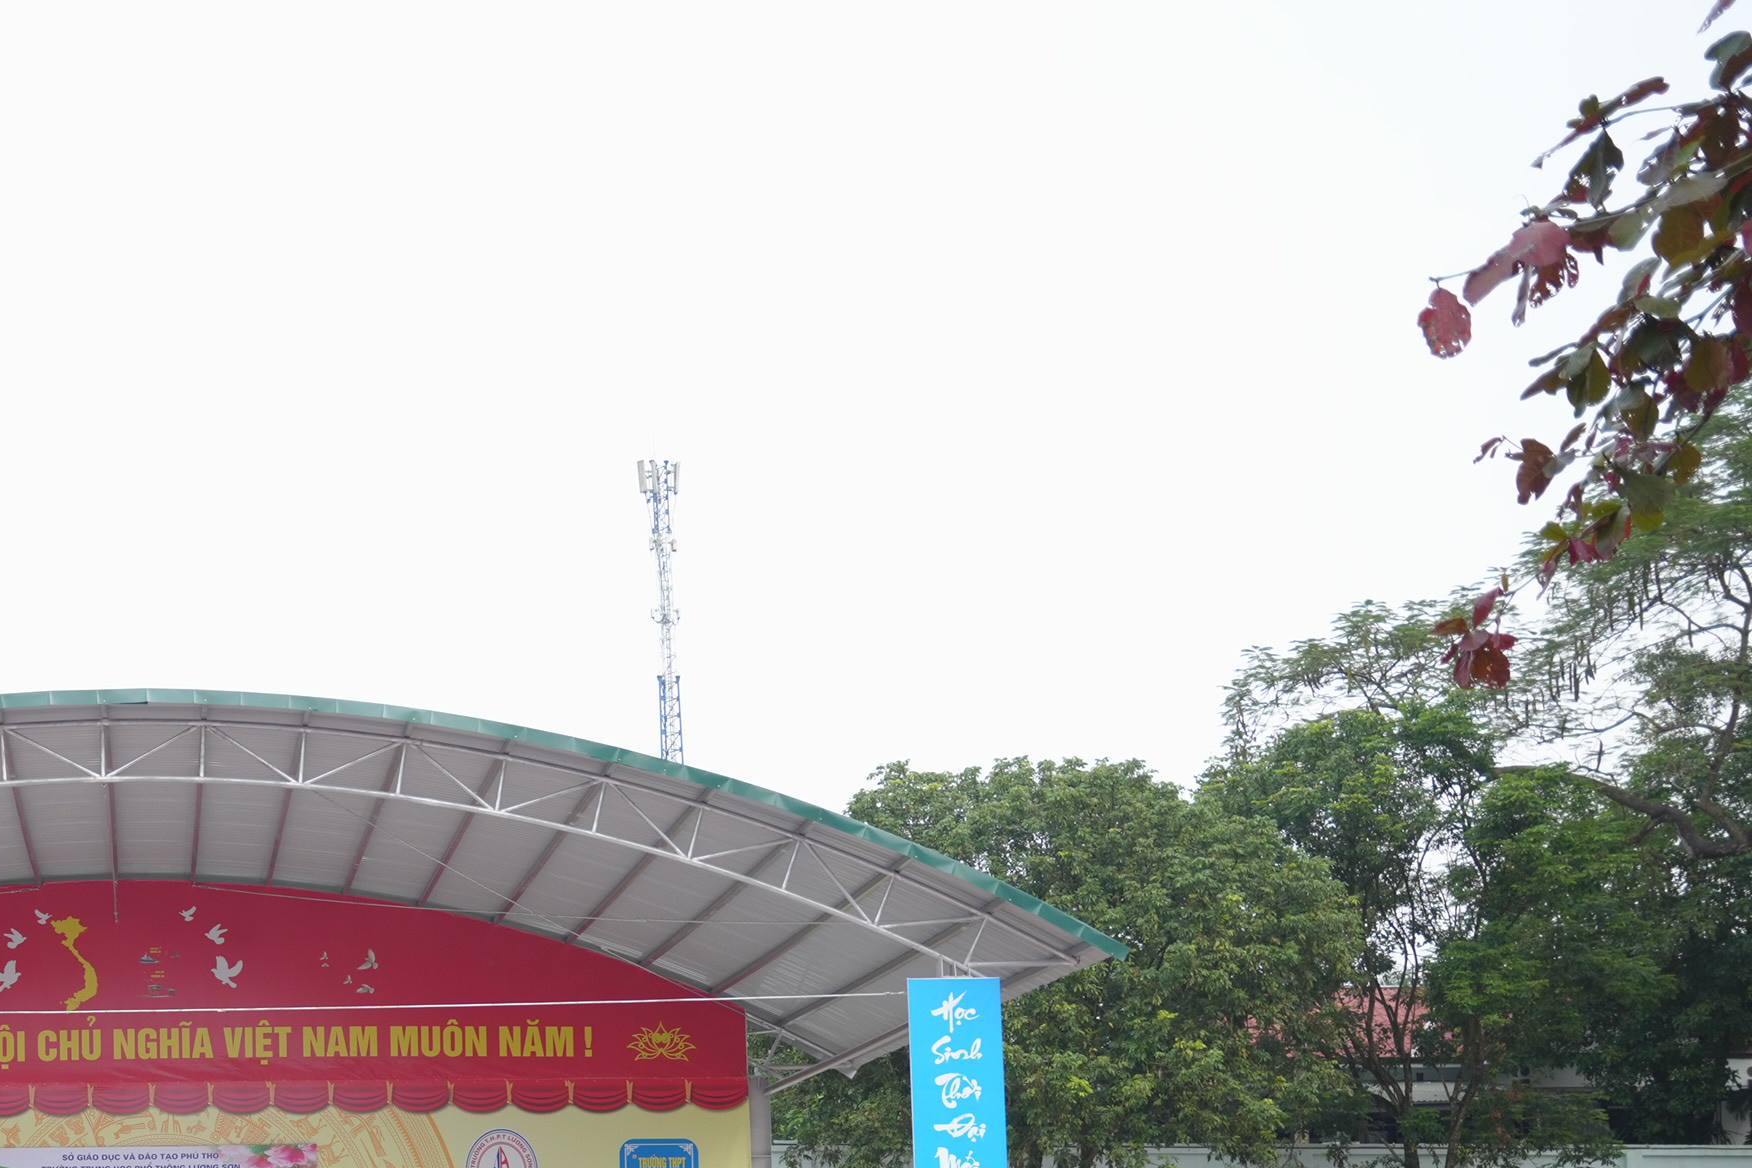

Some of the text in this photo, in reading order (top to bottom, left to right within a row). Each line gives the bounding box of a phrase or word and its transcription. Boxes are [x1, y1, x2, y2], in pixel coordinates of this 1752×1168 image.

[931, 990, 980, 1033] Học
[37, 1015, 102, 1062] CHỦ
[113, 1020, 214, 1060] NGHĨA
[223, 1020, 292, 1065] VIỆT
[303, 1025, 378, 1058] NAM
[390, 1019, 488, 1057] MUÔN
[498, 1018, 574, 1057] NĂM
[931, 1035, 983, 1064] Sinh
[934, 1072, 982, 1109] Thời
[933, 1113, 986, 1143] Đại
[62, 1152, 74, 1161] SỞ
[77, 1152, 99, 1161] GIÁO
[101, 1153, 121, 1162] DỤC
[123, 1152, 135, 1161] VÀ
[138, 1152, 158, 1160] ĐÀO
[160, 1153, 178, 1162] TẠO
[180, 1152, 199, 1160] PHÚ
